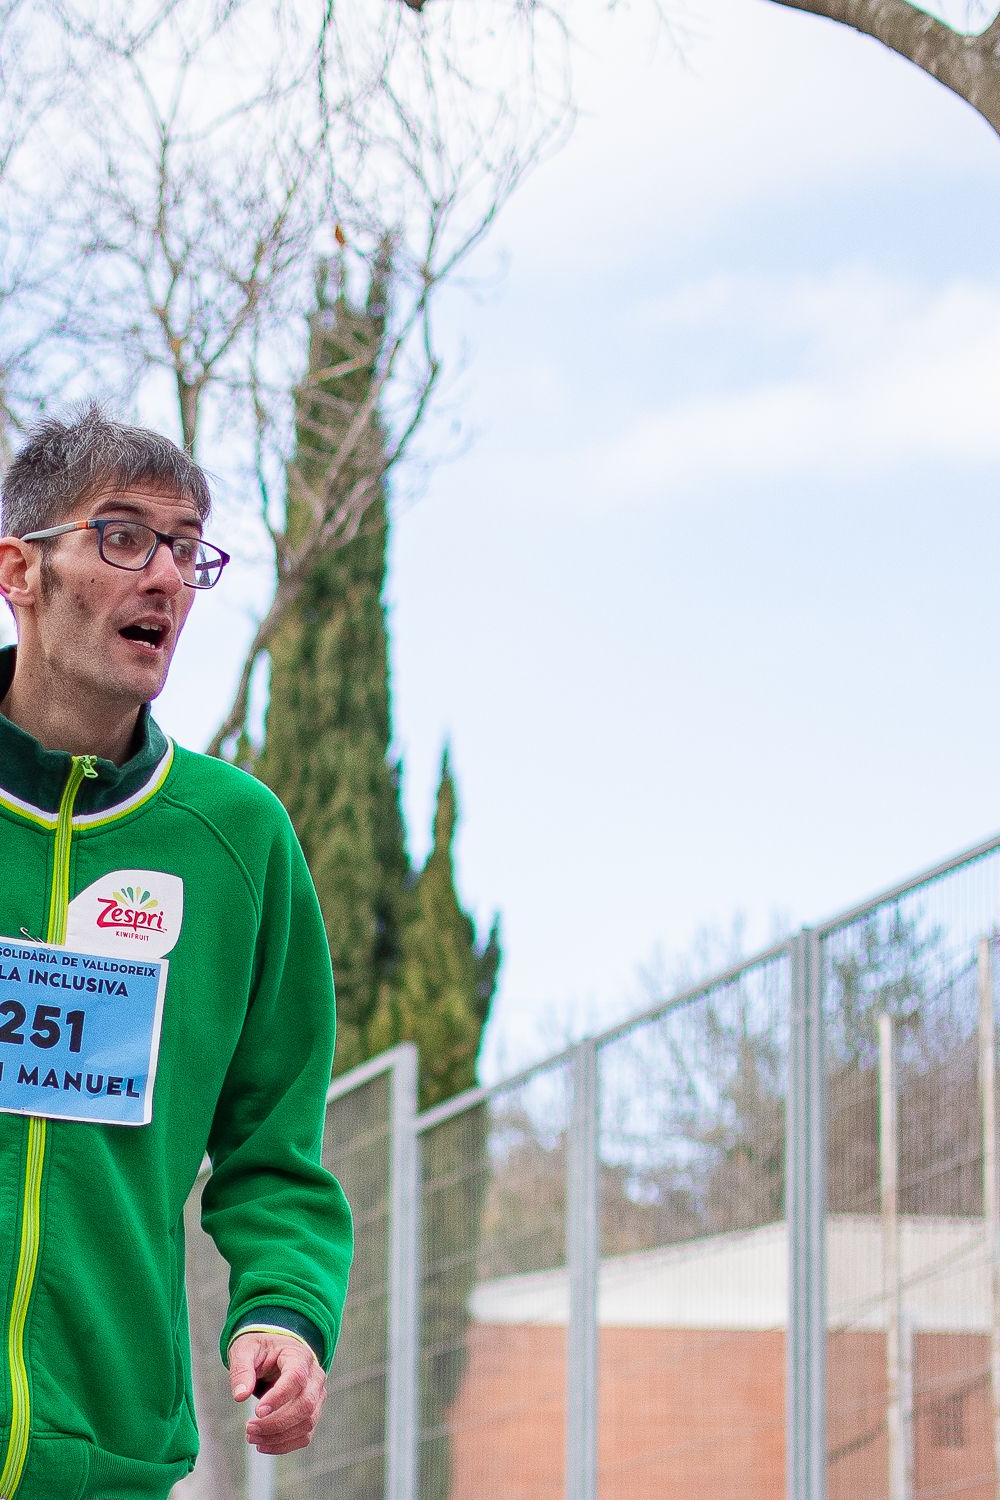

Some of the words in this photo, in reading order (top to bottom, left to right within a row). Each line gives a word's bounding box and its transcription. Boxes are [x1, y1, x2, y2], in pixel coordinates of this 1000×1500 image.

[96, 897, 166, 932] Zespri
[115, 930, 149, 942] KIWIFRUIT
[61, 956, 79, 968] DE
[82, 958, 157, 978] VALLDOREIX
[28, 968, 129, 998] INCLUSIVA
[17, 1064, 140, 1098] MANUEL
